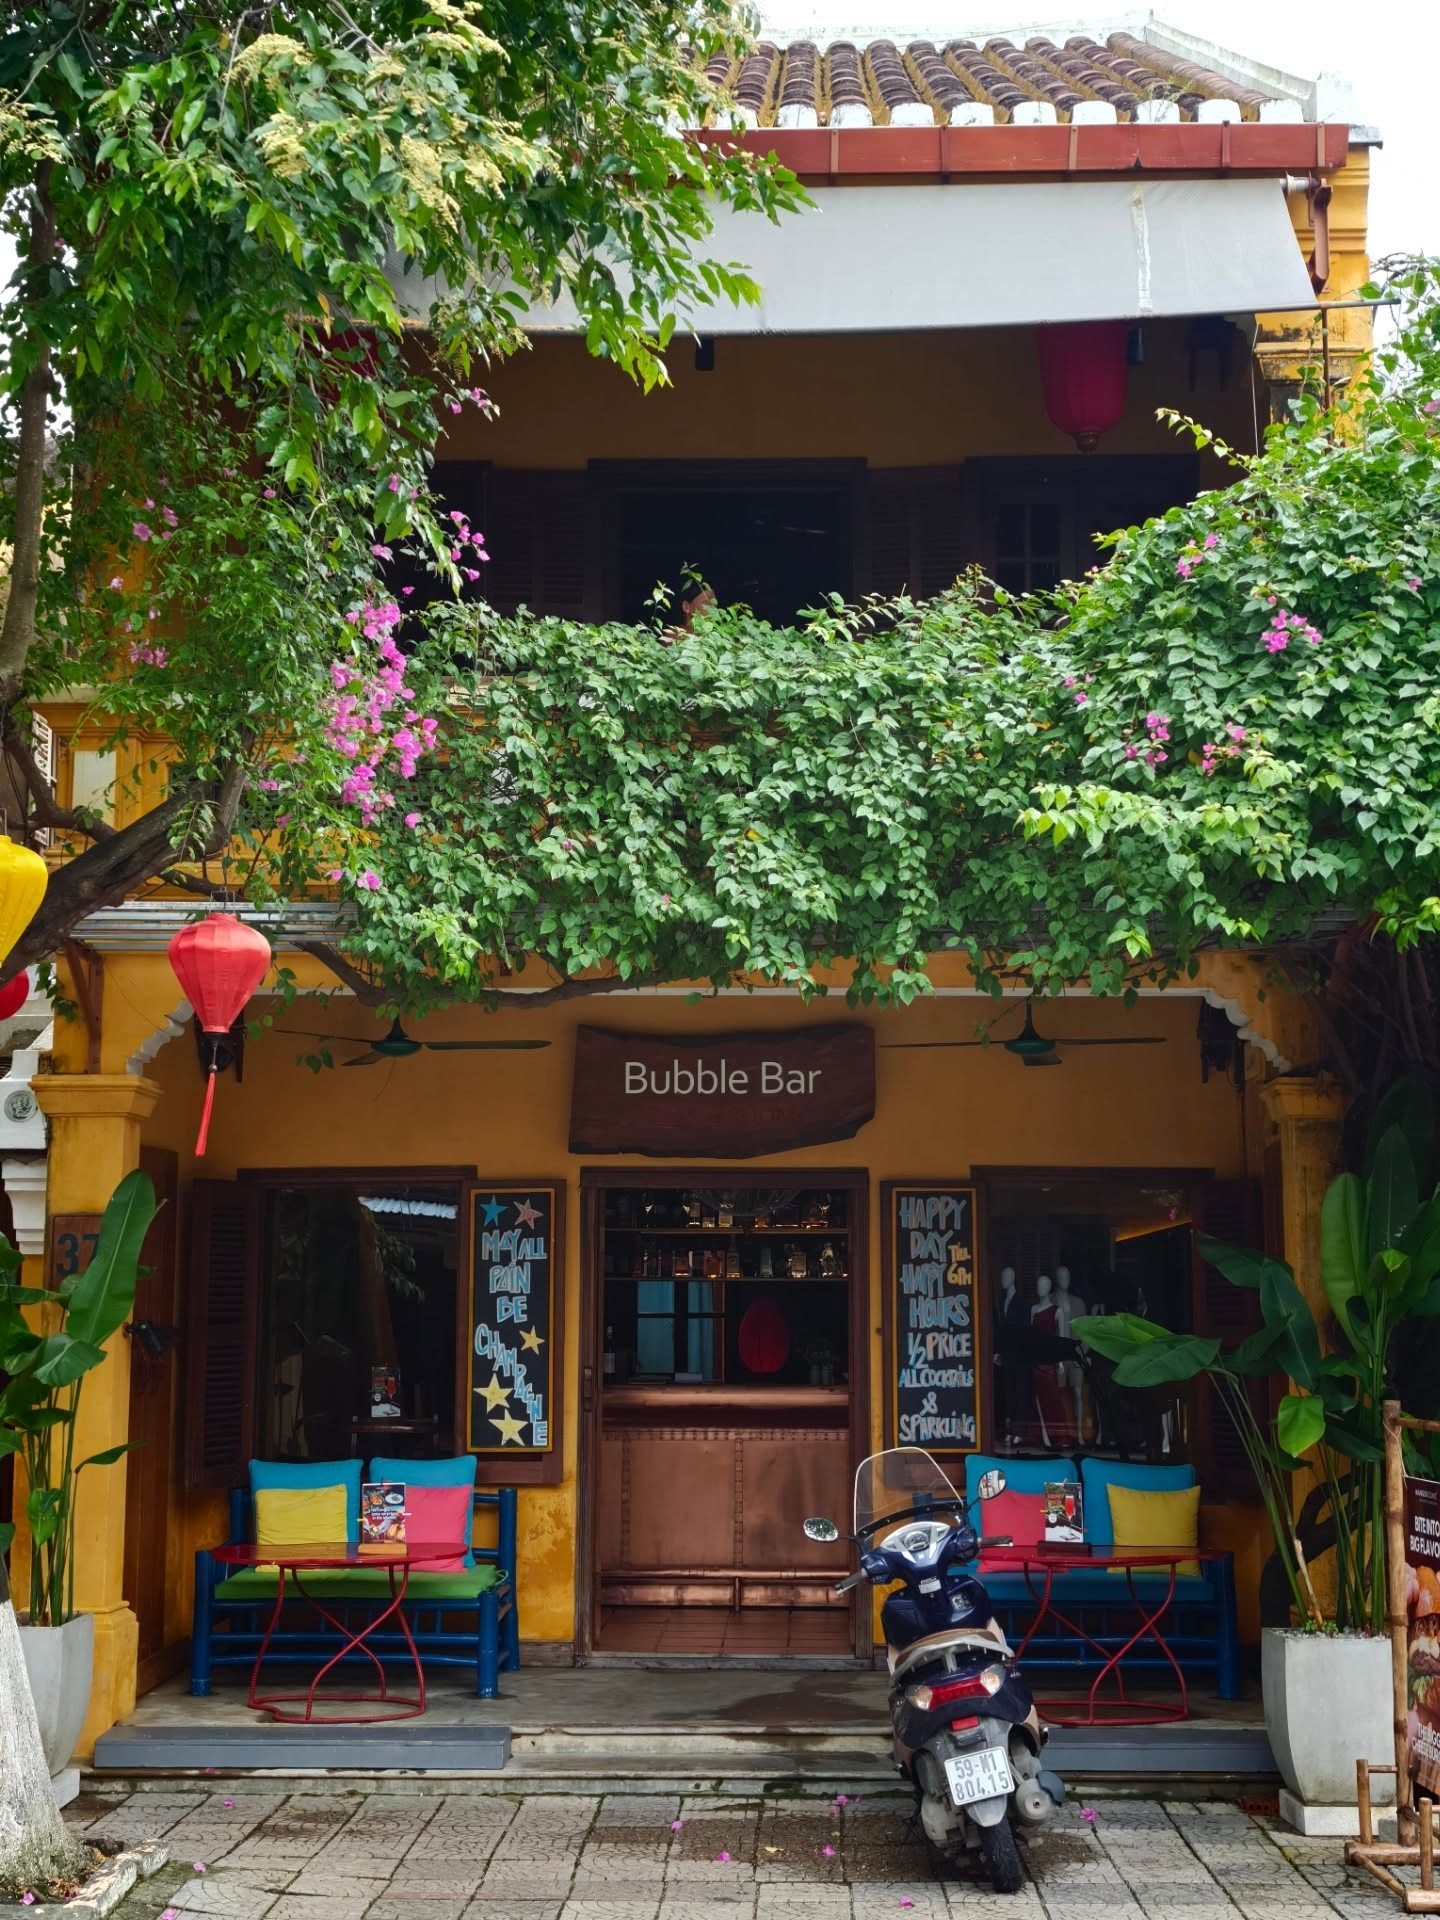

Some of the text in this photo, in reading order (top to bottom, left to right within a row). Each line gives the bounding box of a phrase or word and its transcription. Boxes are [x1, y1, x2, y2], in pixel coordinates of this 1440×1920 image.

[624, 1059, 822, 1094] Bubble Bar
[899, 1196, 967, 1230] HAPPY
[482, 1228, 547, 1262] MAY ALL
[910, 1230, 954, 1262] DAY
[489, 1260, 531, 1294] PAIN
[899, 1261, 947, 1297] HAPPY
[496, 1296, 528, 1323] BE
[909, 1294, 970, 1329] HOURS
[474, 1323, 548, 1446] CHAMPAGNE
[1420, 1537, 1440, 1559] FLAVO
[955, 1771, 1009, 1800] 804.15
